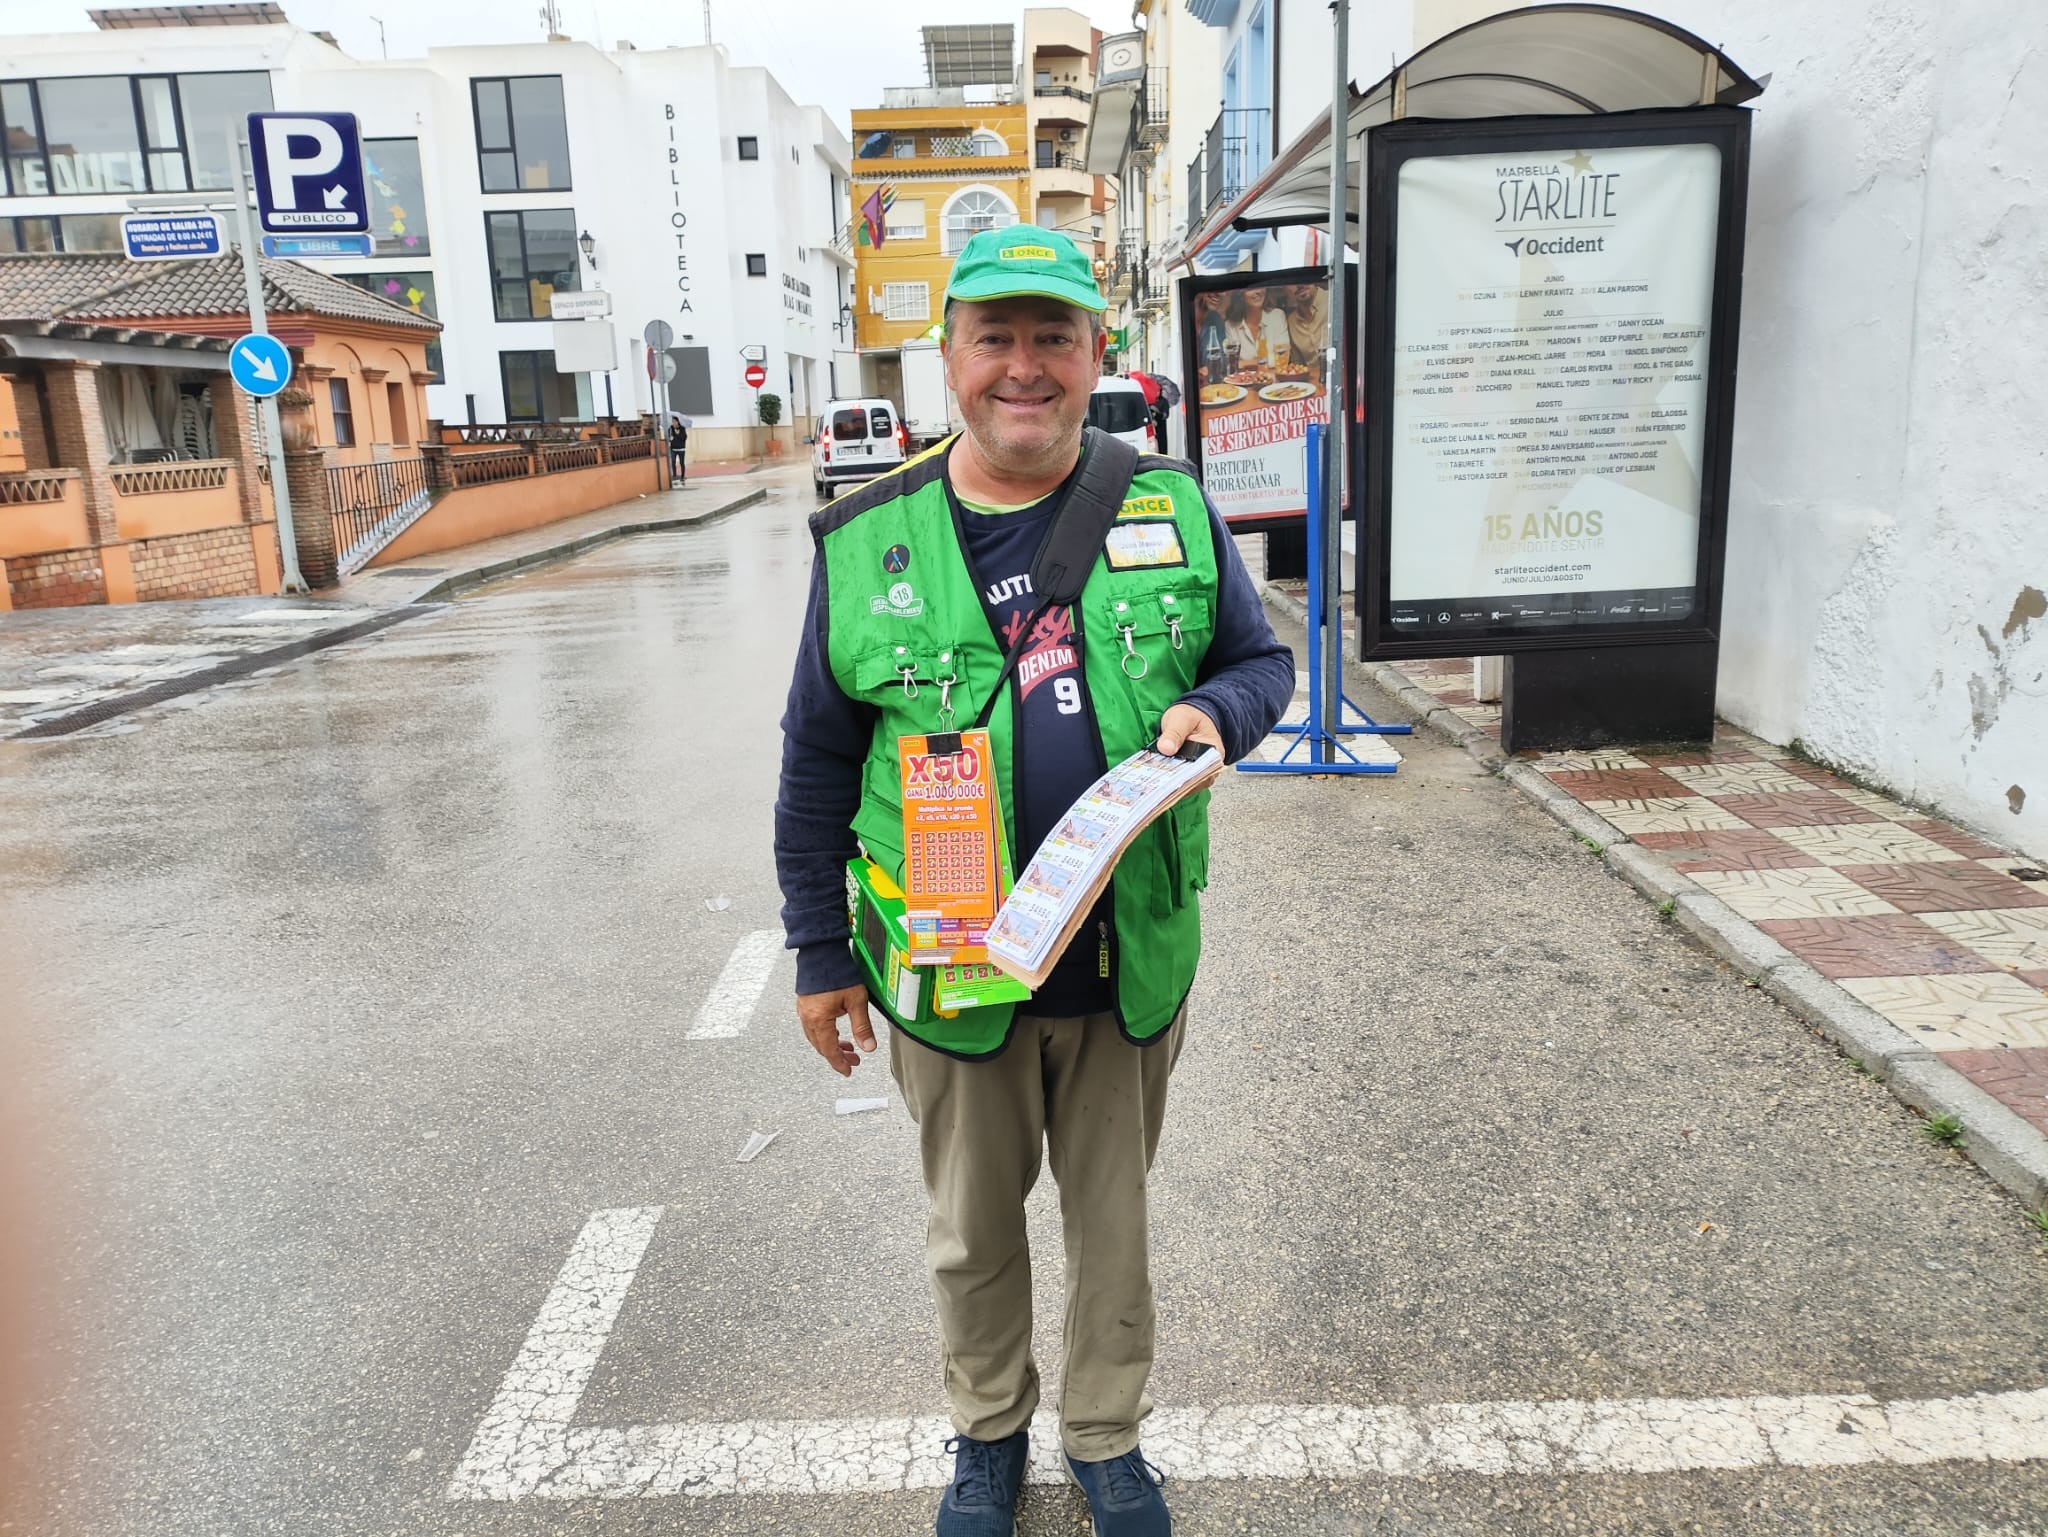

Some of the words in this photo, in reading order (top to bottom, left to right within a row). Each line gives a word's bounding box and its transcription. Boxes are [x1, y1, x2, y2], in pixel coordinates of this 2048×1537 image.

[262, 118, 344, 210] P
[1496, 165, 1560, 177] MARBELLA
[1495, 174, 1620, 222] STARLITE
[665, 104, 693, 313] BIBLIOTECA
[127, 222, 159, 233] HORARIO
[161, 222, 171, 231] DE
[172, 221, 197, 231] SALIDA
[283, 214, 346, 223] PUBLICO
[131, 233, 166, 243] ENTRADAS
[167, 232, 177, 242] DE
[191, 231, 197, 240] A
[300, 241, 341, 251] LIBRE
[1526, 236, 1604, 256] Occident
[1017, 249, 1051, 258] ONCE
[1543, 275, 1565, 283] JUNIO
[1519, 290, 1543, 298] LENNY
[1544, 288, 1574, 297] KRAVITZ
[1597, 286, 1616, 294] ALAN
[1617, 284, 1649, 293] PARSONS
[1543, 309, 1564, 318] JULIO
[1449, 328, 1470, 336] GIPSY
[1471, 326, 1493, 335] KINGS
[1617, 319, 1640, 328] DANNY
[1641, 318, 1665, 327] OCEAN
[1407, 344, 1430, 353] ELENA
[1431, 343, 1449, 352] ROSE
[1468, 341, 1491, 350] GRUPO
[1492, 340, 1529, 349] FRONTERA
[1547, 337, 1576, 346] MAROON
[1599, 334, 1617, 343] DEEP
[1618, 333, 1643, 342] PURPLE
[1662, 331, 1679, 340] RICK
[1680, 330, 1706, 339] ASTLEY
[1426, 358, 1446, 366] ELVIS
[1446, 356, 1474, 365] CRESPO
[1496, 353, 1542, 363] JEAN-MICHEL
[1543, 351, 1566, 360] JARRE
[1586, 350, 1606, 358] MORA
[1625, 348, 1650, 356] YANDEL
[1422, 372, 1441, 381] JOHN
[1441, 371, 1469, 380] LEGEND
[1490, 369, 1512, 378] DIANA
[1513, 367, 1536, 376] KRALL
[1560, 365, 1587, 374] CARLOS
[1588, 363, 1613, 373] RIVERA
[1633, 361, 1651, 370] KOOL
[1652, 361, 1658, 369] &
[1659, 360, 1673, 369] THE
[1674, 359, 1694, 368] GANG
[1412, 386, 1437, 396] MIGUEL
[1475, 383, 1512, 393] ZUCCHERO
[1536, 380, 1565, 390] MANUEL
[1566, 378, 1590, 388] TURIZO
[1633, 375, 1654, 385] RICKY
[1674, 373, 1702, 383] ROSANA
[1535, 400, 1563, 409] AGOSTO
[1208, 406, 1277, 437] MOMENTOS
[1279, 399, 1306, 425] QUE
[1419, 421, 1449, 430] ROSARIO
[1509, 417, 1534, 426] SERGIO
[1535, 416, 1559, 425] DALMA
[1578, 413, 1601, 423] GENTE
[1602, 413, 1611, 421] DE
[1611, 412, 1630, 420] ZONA
[1650, 409, 1688, 419] DELAOSSA
[1208, 435, 1225, 456] SE
[1226, 425, 1270, 452] SIRVEN
[1271, 421, 1289, 443] EN
[1289, 418, 1308, 438] TU
[1448, 435, 1457, 443] DE
[1458, 433, 1477, 442] LUNA
[1484, 432, 1497, 441] NIL
[1497, 431, 1528, 441] MOLINER
[1589, 426, 1616, 436] HAUSER
[1652, 423, 1686, 432] FERREIRO
[1442, 448, 1469, 457] VANESA
[1516, 445, 1540, 454] OMEGA
[1550, 441, 1595, 451] ANIVERSARIO
[1206, 459, 1258, 477] PARTICIPA
[1259, 458, 1265, 472] Y
[1449, 459, 1485, 469] TABURETE
[1525, 455, 1560, 465] ANTOÑITO
[1560, 454, 1586, 463] MOLINA
[1608, 451, 1639, 461] ANTONIO
[1248, 473, 1281, 489] GANAR
[1453, 472, 1485, 482] PASTORA
[1485, 471, 1508, 480] SOLER
[1530, 469, 1556, 478] GLORIA
[1556, 467, 1577, 477] TREVI
[1596, 465, 1615, 475] LOVE
[1615, 465, 1624, 473] OF
[1625, 463, 1656, 473] LESBIAN
[1120, 499, 1169, 514] ONCE
[1483, 513, 1512, 541] 15
[1520, 504, 1603, 540] AÑOS
[1560, 537, 1605, 552] SENTIR
[1494, 563, 1592, 575] starliteoccident.com
[1501, 573, 1584, 584] JUNIO/JULIO/AGOSTO
[1018, 648, 1073, 687] DENIM
[1053, 677, 1082, 715] 9
[906, 788, 923, 798] GANA
[949, 813, 960, 821] x20
